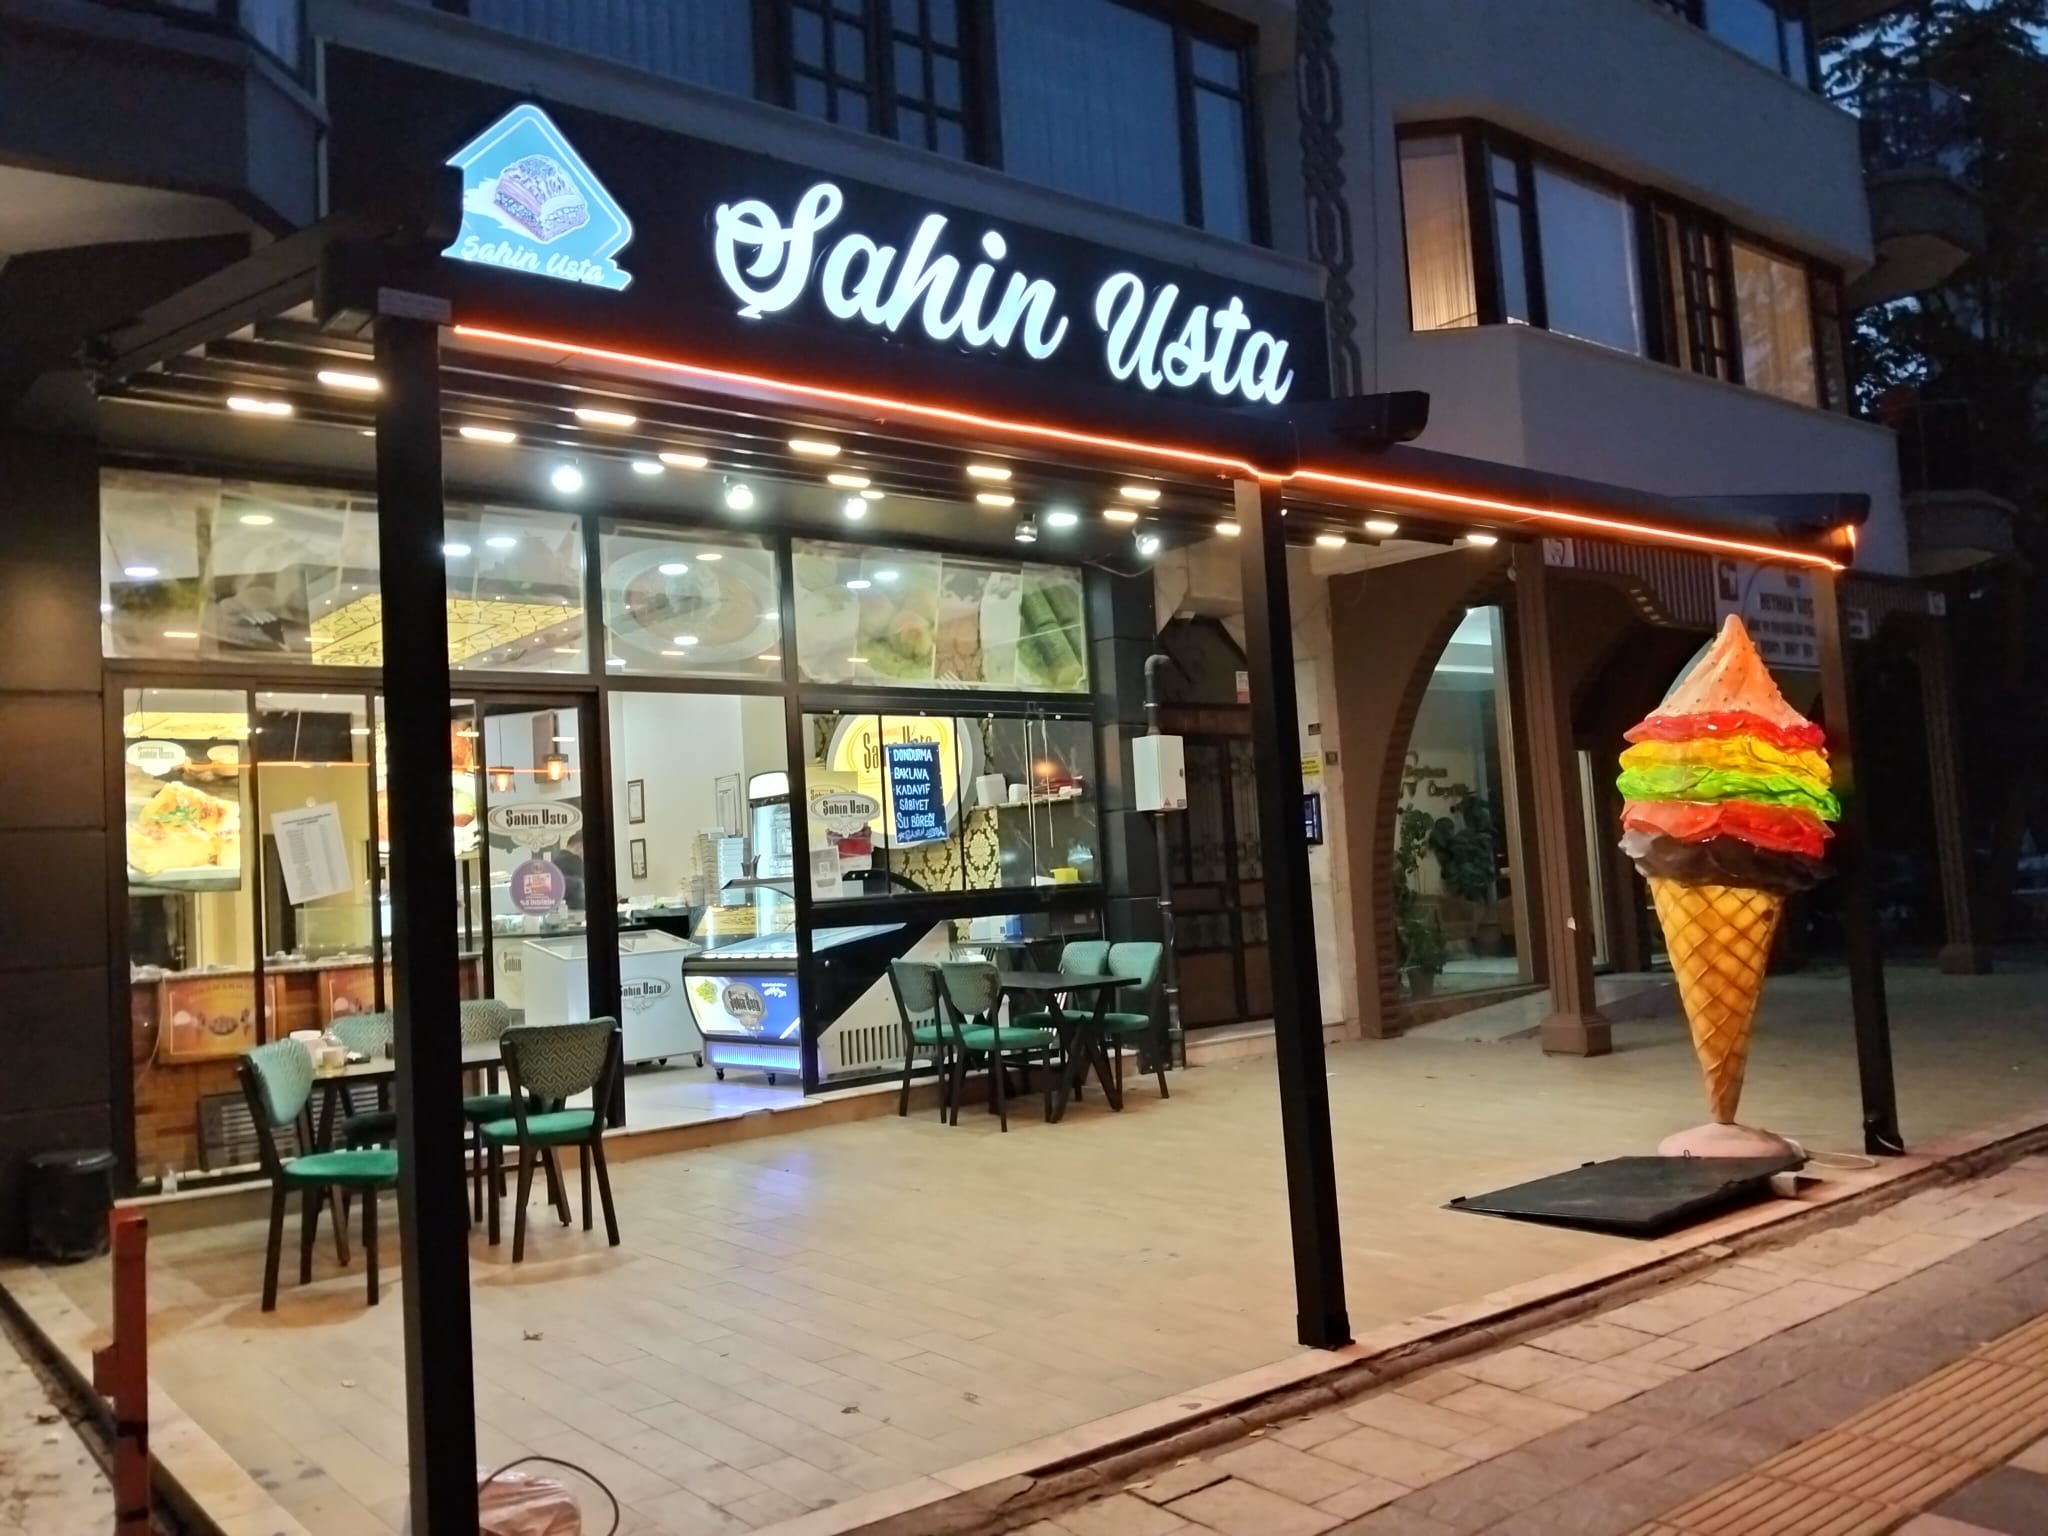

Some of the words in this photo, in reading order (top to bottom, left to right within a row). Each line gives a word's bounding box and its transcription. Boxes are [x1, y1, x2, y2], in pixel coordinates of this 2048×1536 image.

[546, 253, 605, 283] Usta
[1095, 271, 1294, 405] Usta
[893, 748, 933, 762] DONDURMA
[893, 766, 930, 781] BAKLAVA
[895, 783, 931, 796] KADAYIF
[849, 799, 870, 814] Usta
[541, 808, 568, 825] Usta
[642, 981, 662, 994] Usta
